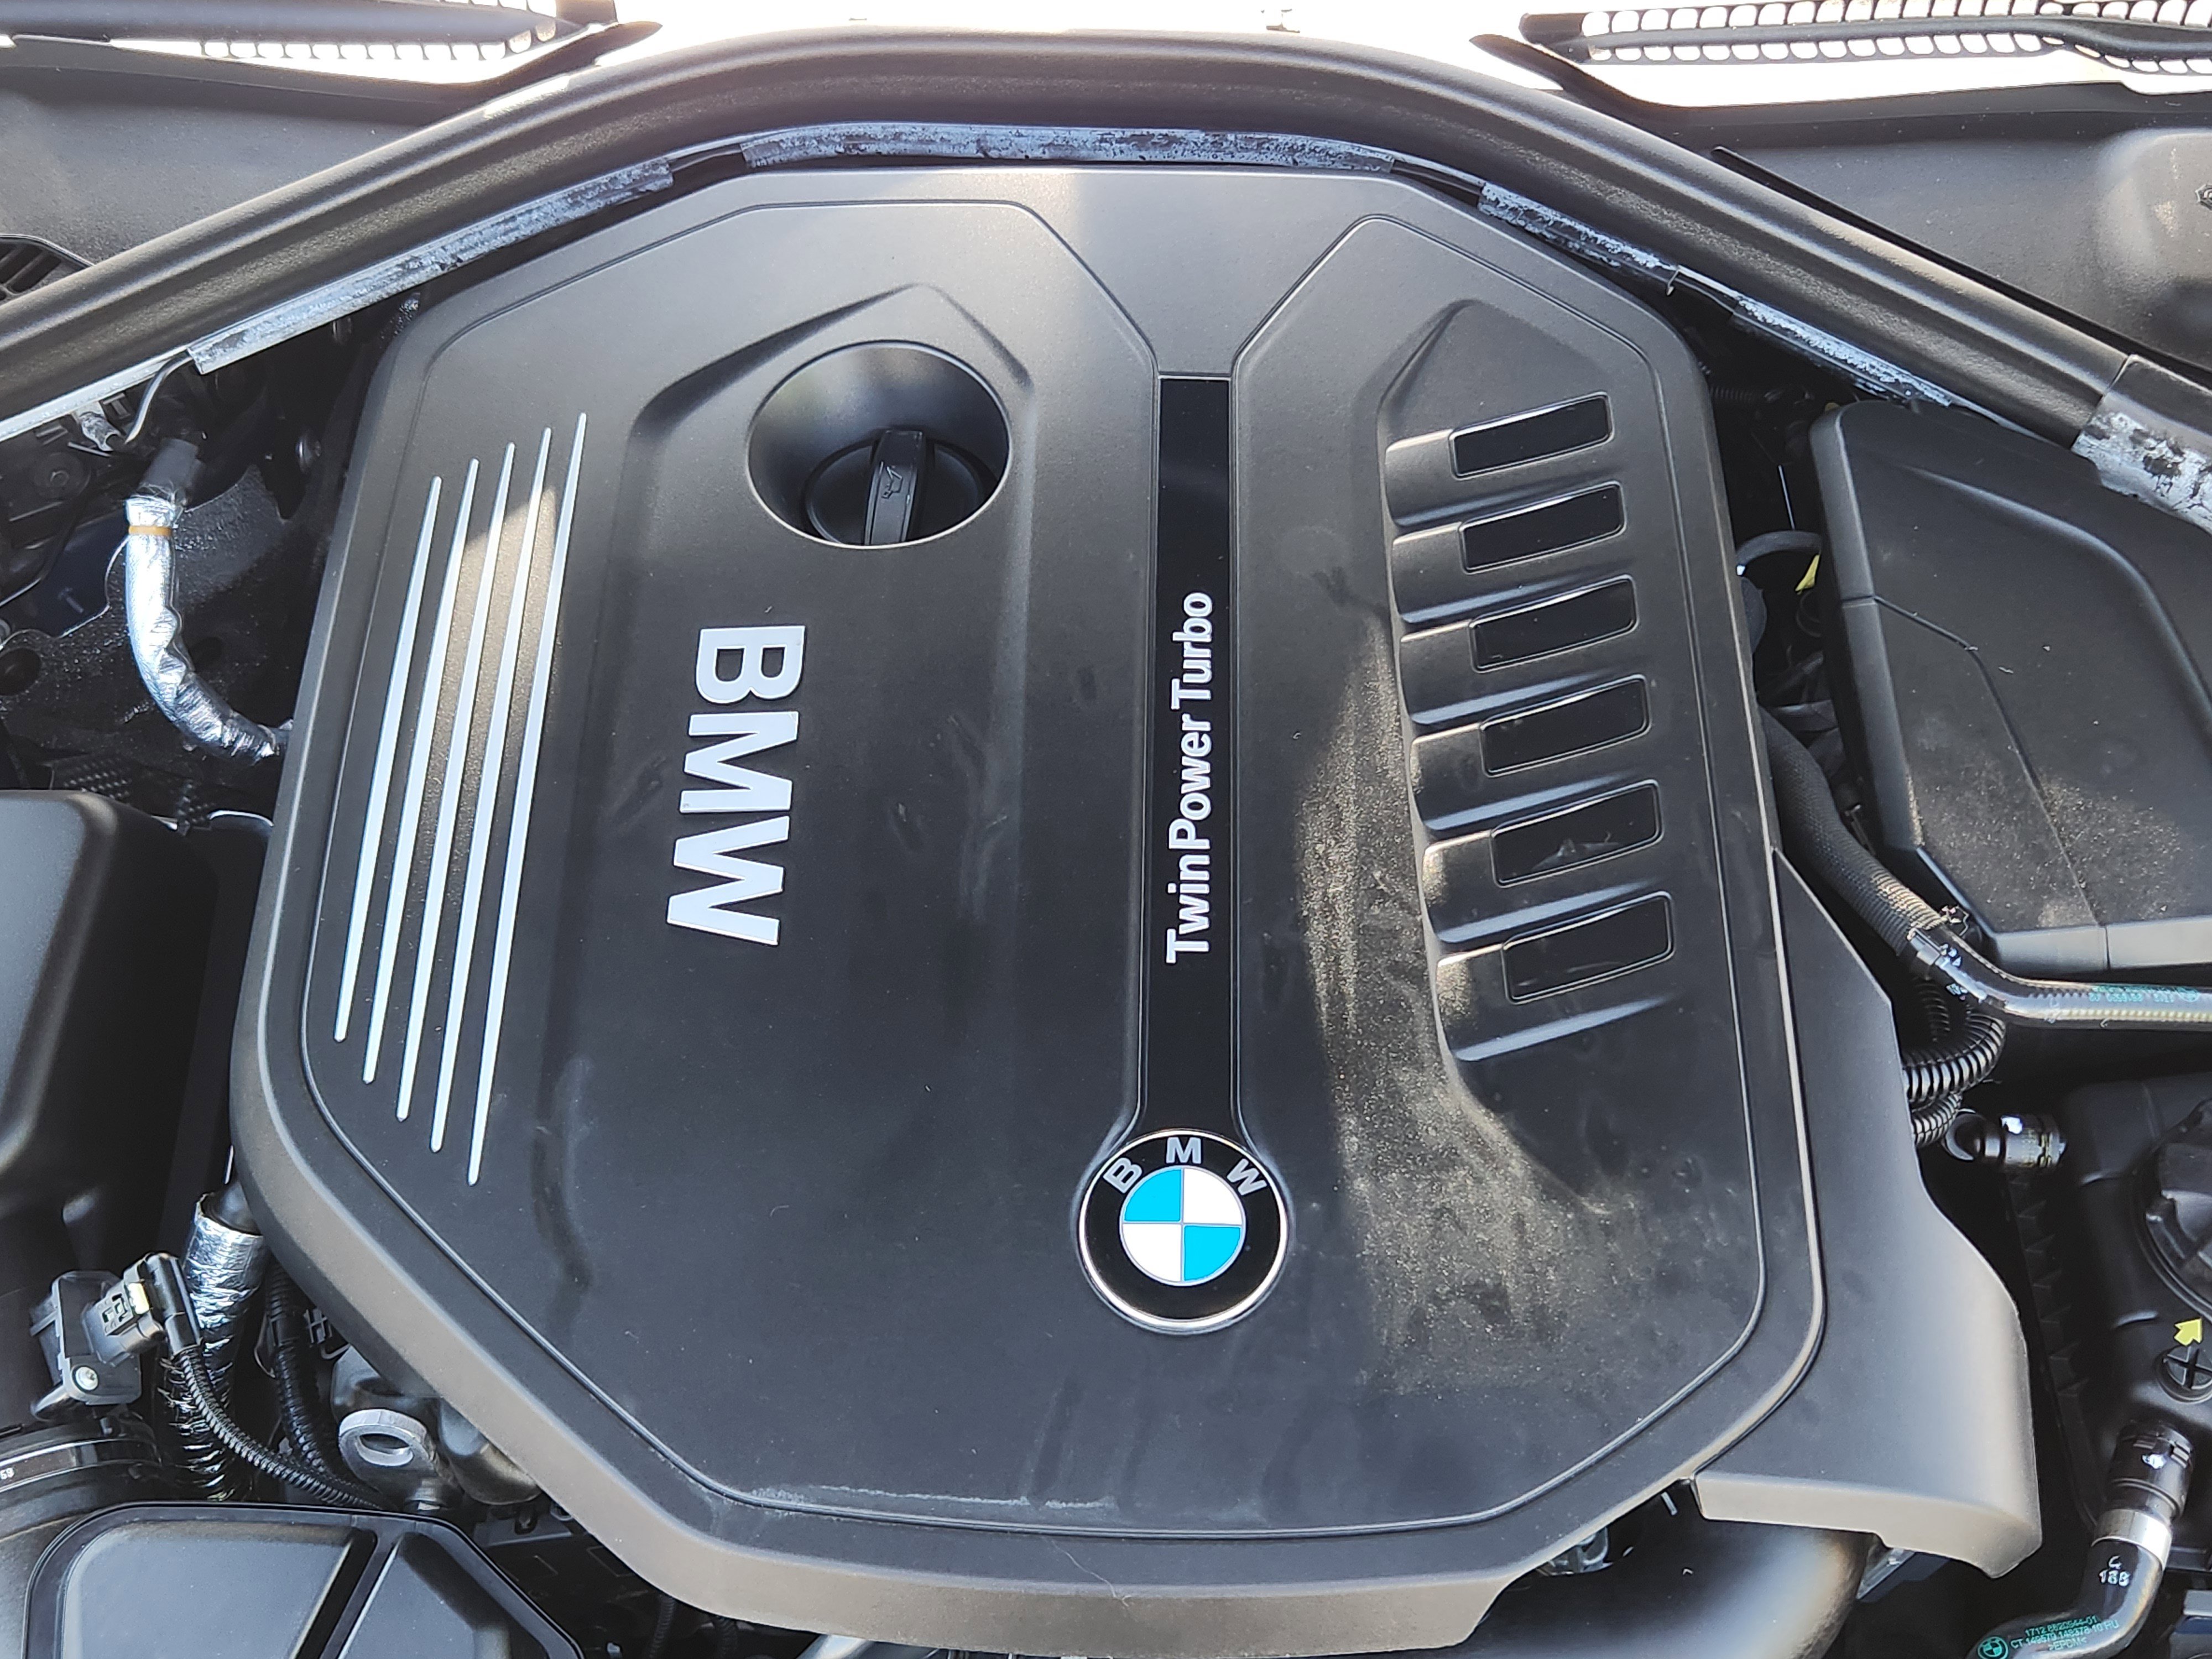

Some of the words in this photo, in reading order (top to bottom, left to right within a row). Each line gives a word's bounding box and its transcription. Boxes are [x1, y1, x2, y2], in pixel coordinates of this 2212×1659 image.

[1170, 592, 1213, 710] Turbo
[666, 625, 806, 946] BMW
[1165, 712, 1212, 964] TwinPower
[1103, 1136, 1268, 1196] BMW
